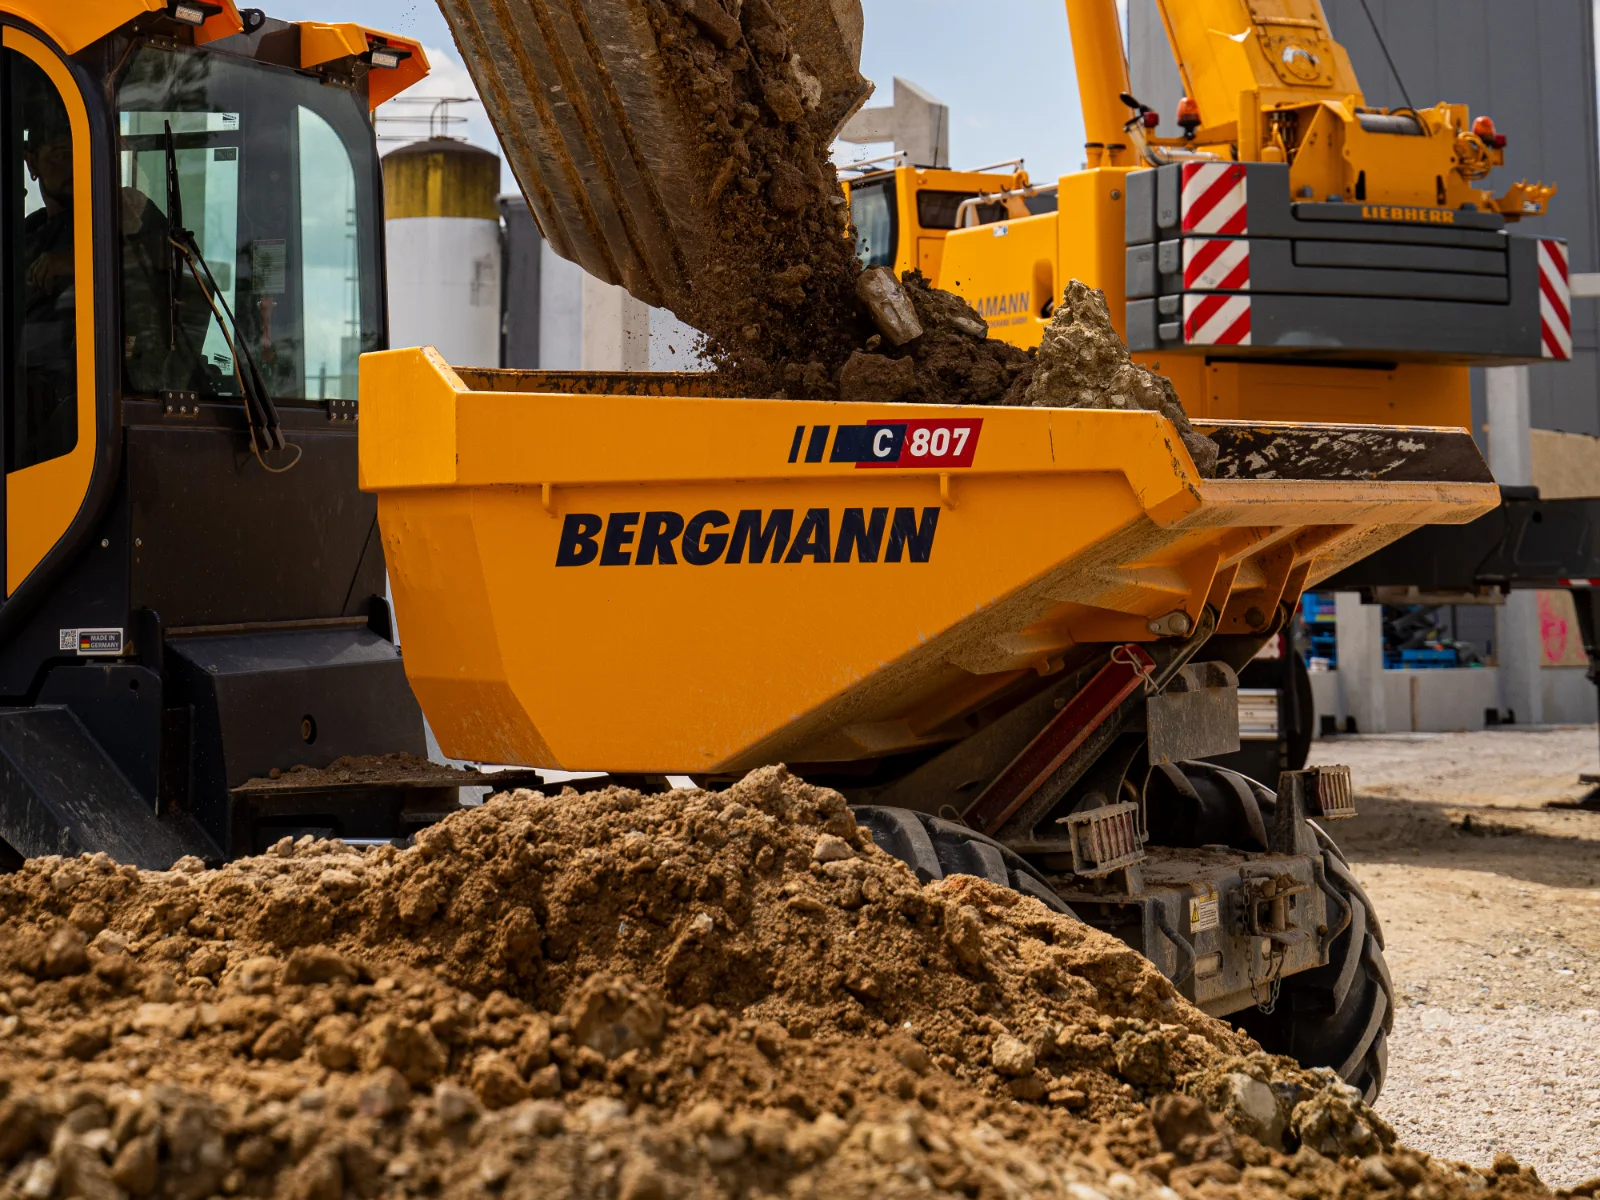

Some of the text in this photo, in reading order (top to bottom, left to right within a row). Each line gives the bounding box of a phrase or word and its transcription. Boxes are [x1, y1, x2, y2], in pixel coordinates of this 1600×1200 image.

[1362, 206, 1454, 224] LIEBHERR
[873, 427, 971, 458] C 807
[555, 506, 940, 567] BERGMANN
